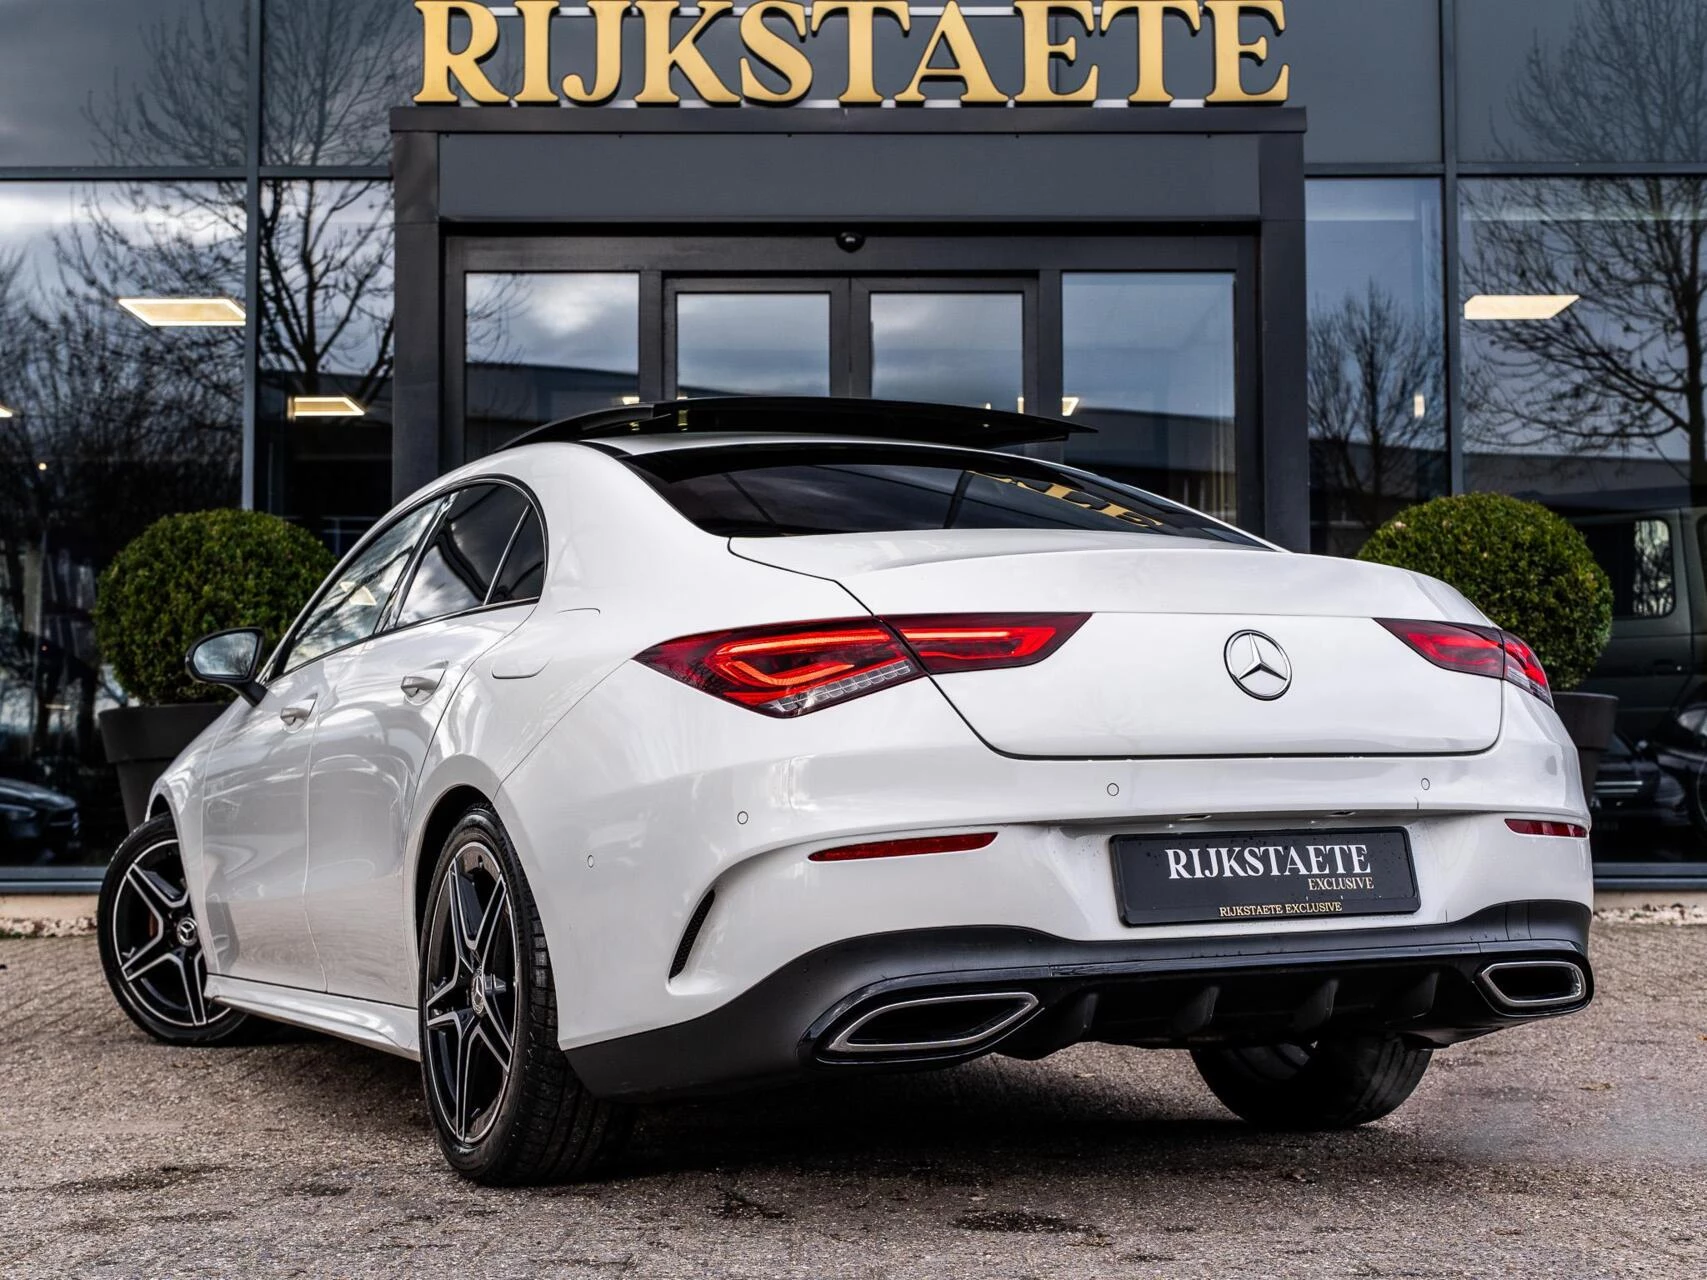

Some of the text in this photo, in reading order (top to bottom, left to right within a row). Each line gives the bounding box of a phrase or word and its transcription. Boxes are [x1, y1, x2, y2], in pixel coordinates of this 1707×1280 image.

[414, 0, 1290, 106] RIJKSTAETE
[1165, 844, 1371, 879] RIJKSTAETE
[1308, 877, 1374, 891] EXCLUSIVE
[1219, 901, 1342, 917] RIJKSTAETE EXCLUSIVE
